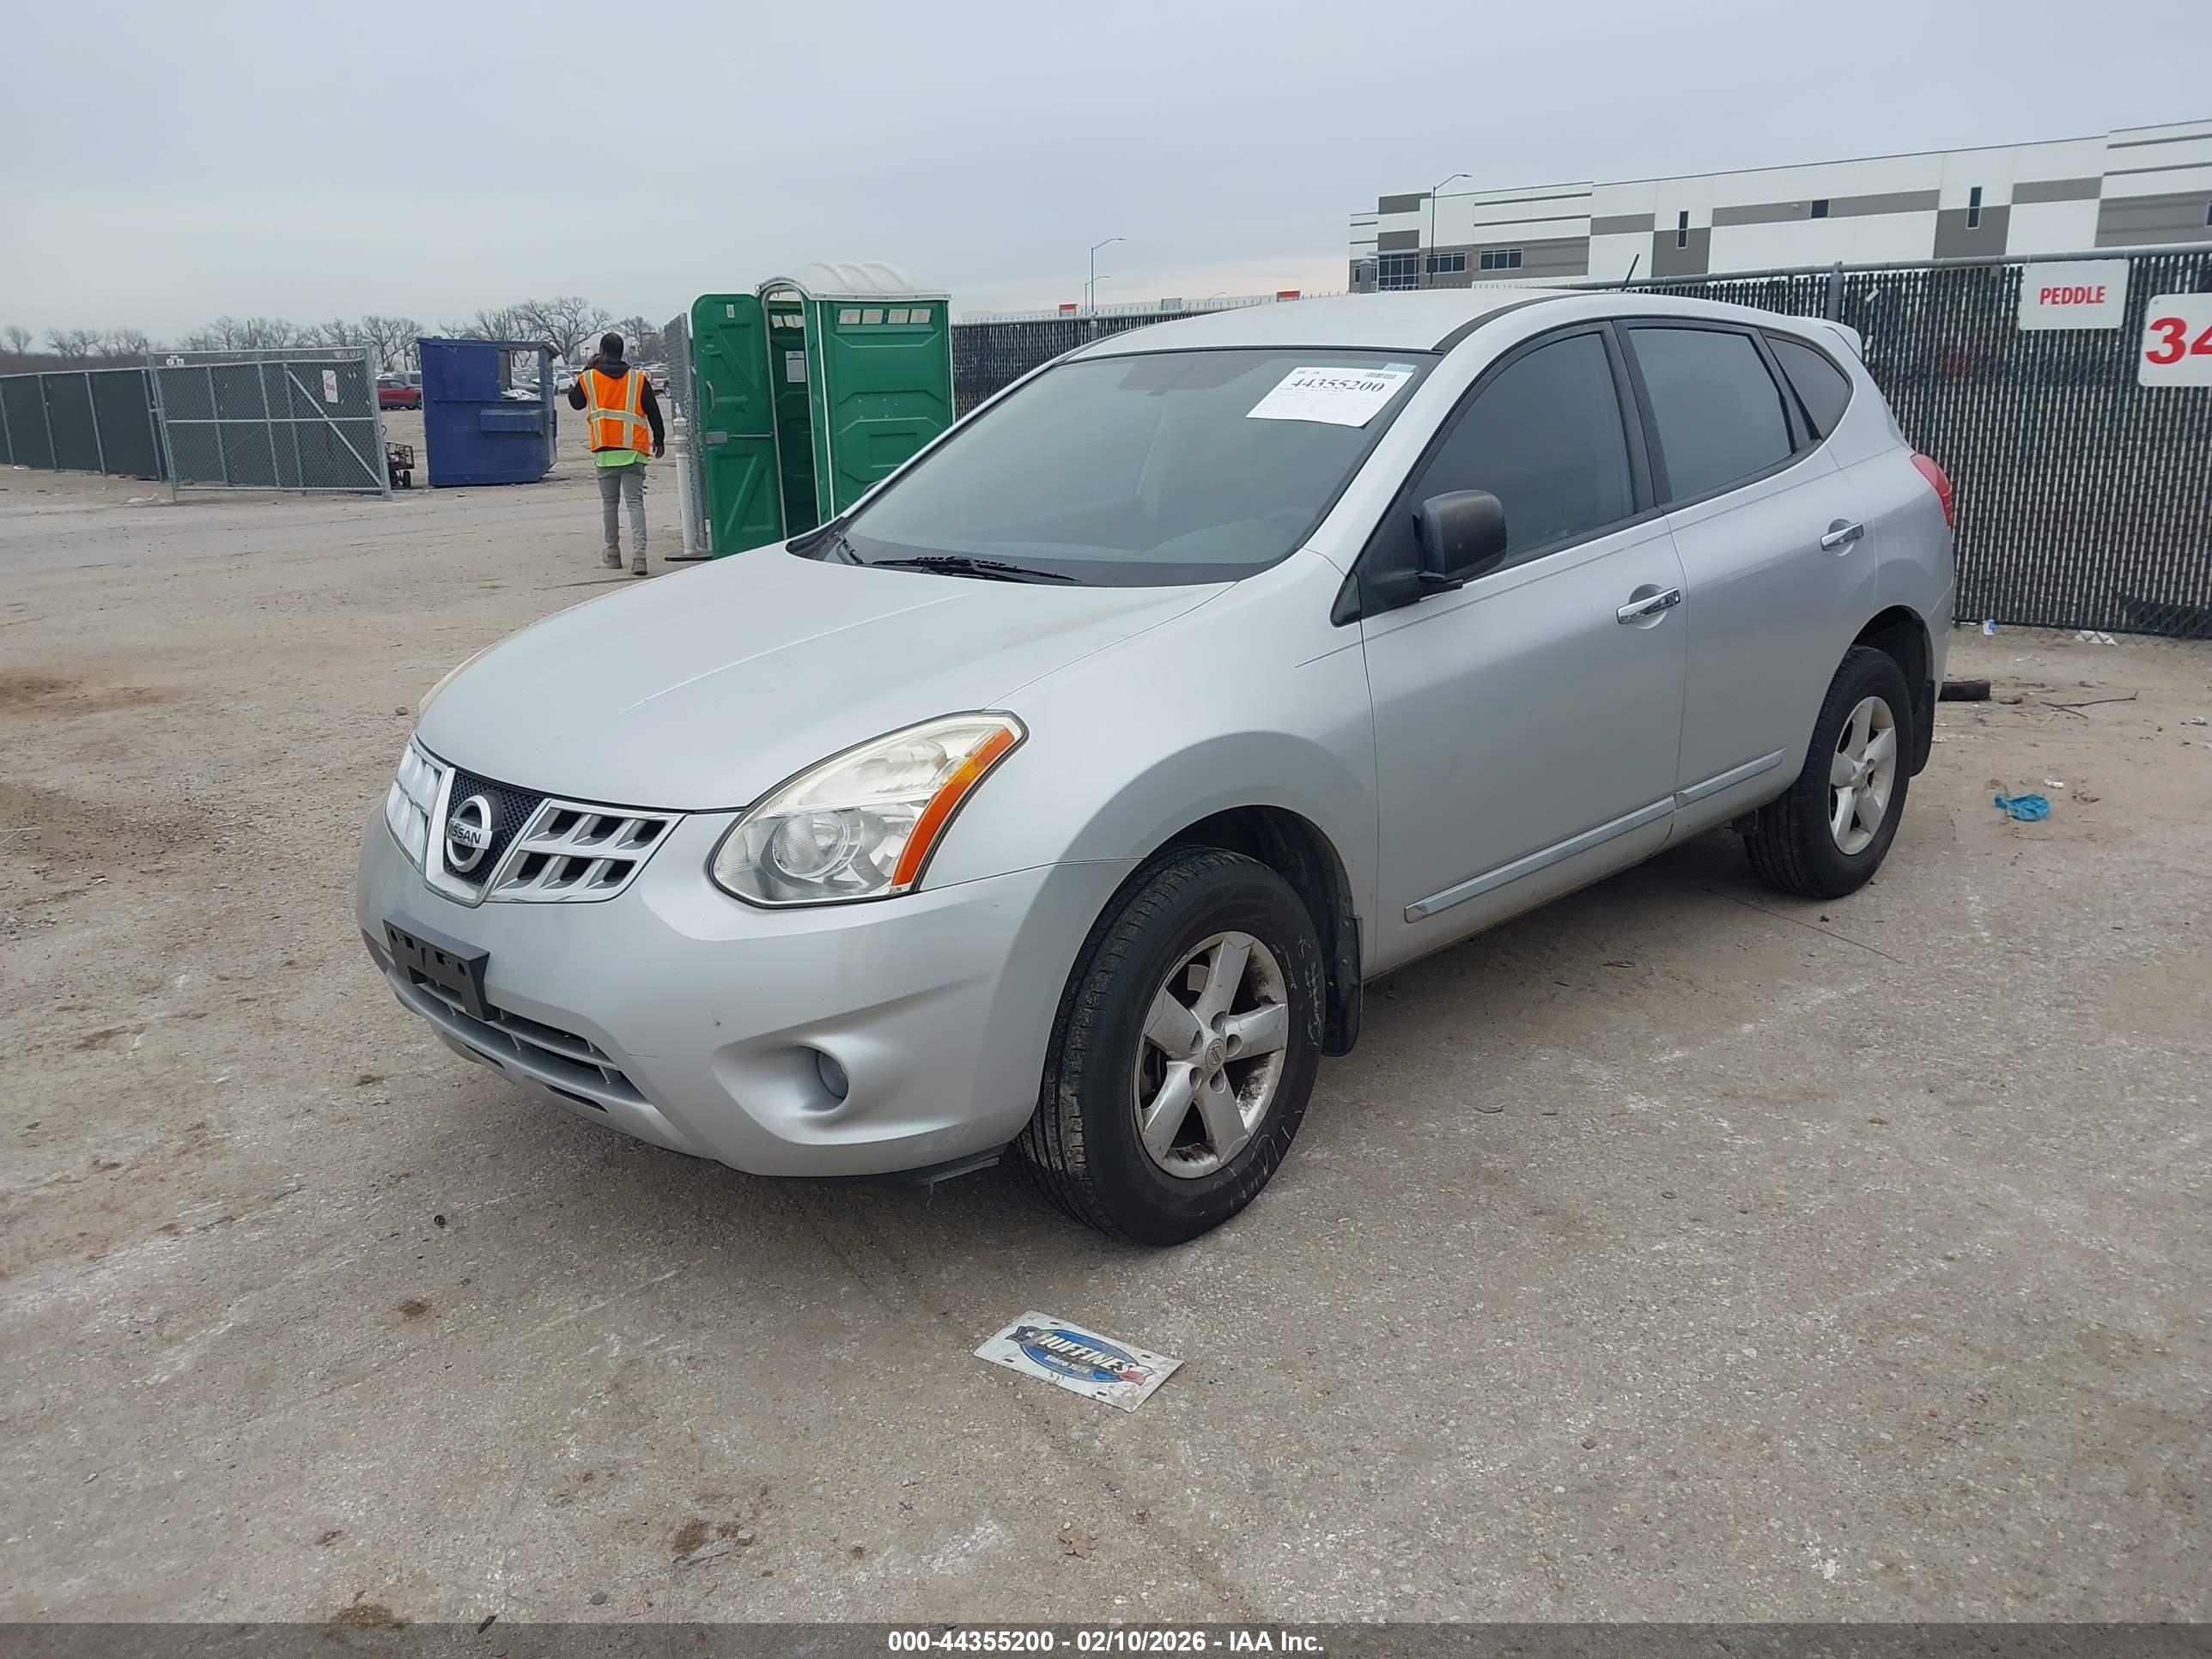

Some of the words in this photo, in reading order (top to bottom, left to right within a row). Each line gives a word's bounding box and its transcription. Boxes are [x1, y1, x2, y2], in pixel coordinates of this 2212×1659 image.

[2039, 286, 2106, 305] PEDDLE
[1291, 378, 1385, 392] 44355200
[1036, 1332, 1137, 1373] HUFFINES
